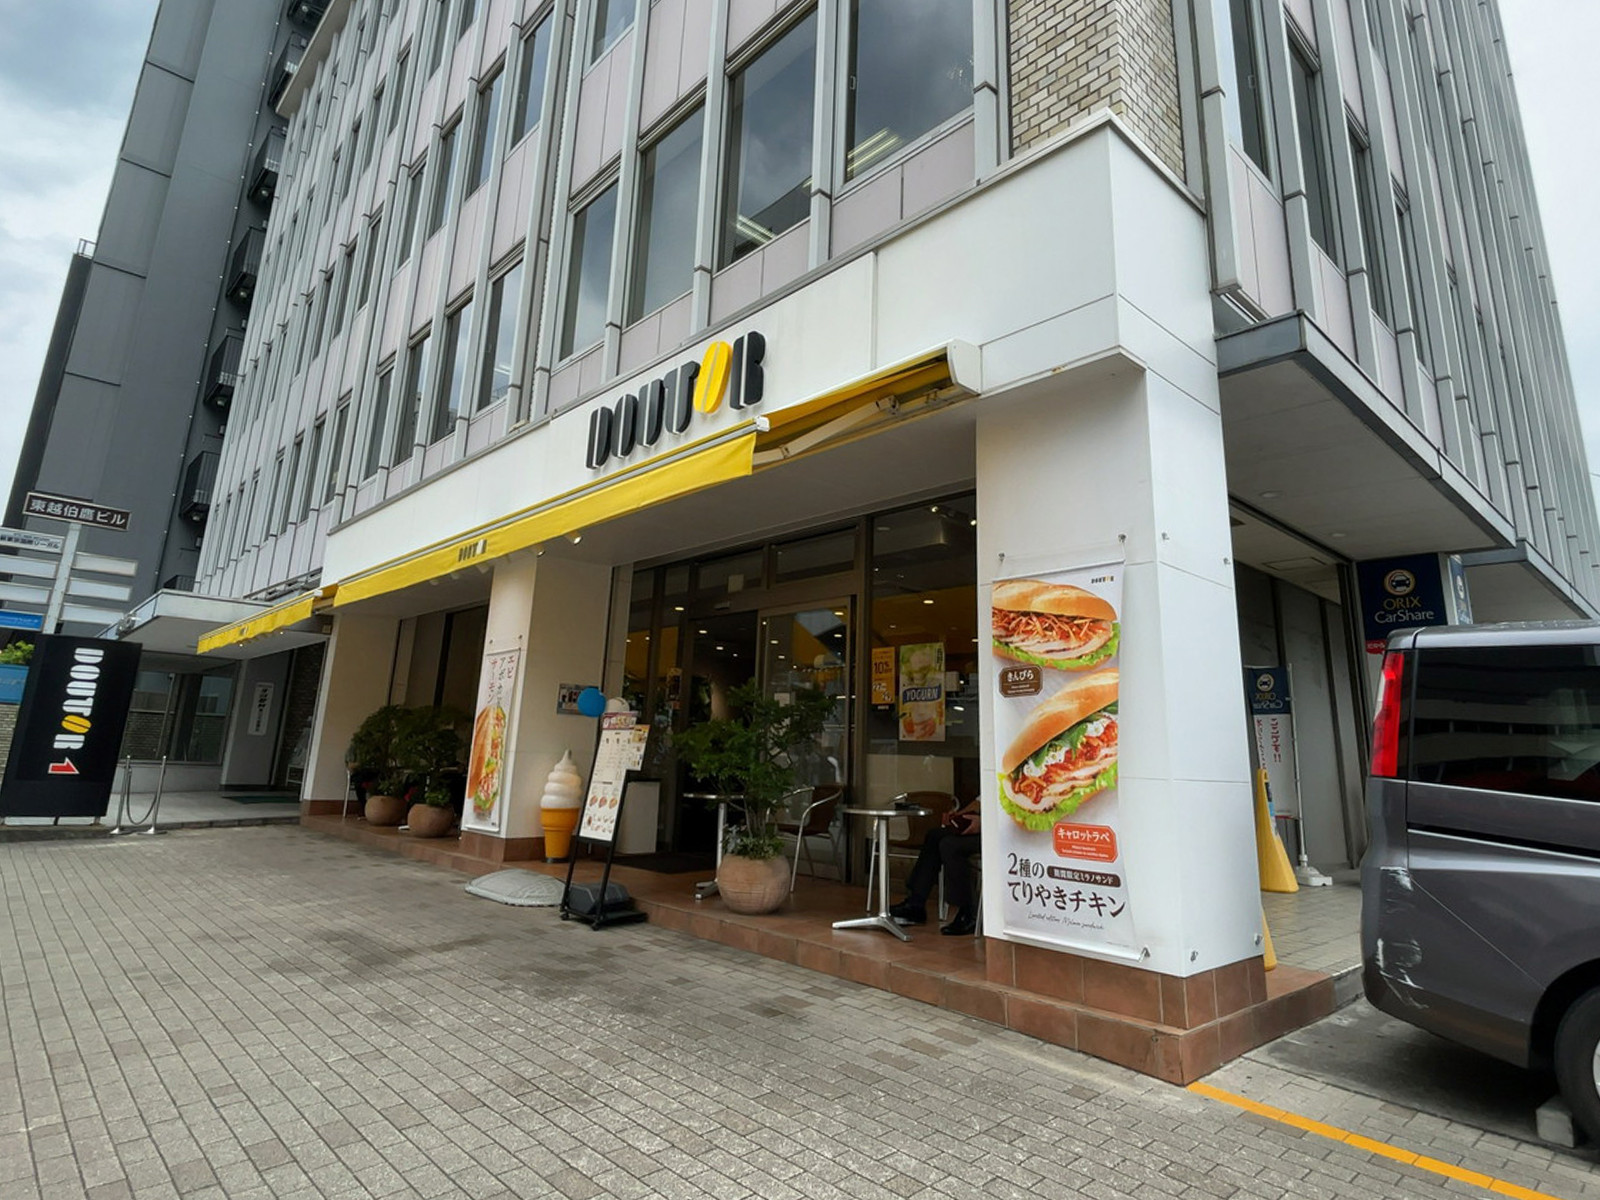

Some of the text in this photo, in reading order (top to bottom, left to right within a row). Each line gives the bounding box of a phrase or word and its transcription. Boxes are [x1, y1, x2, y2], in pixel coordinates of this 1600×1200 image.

[586, 331, 766, 470] DOUTOR
[1374, 609, 1435, 624] CarShare
[1383, 596, 1422, 610] ORIX
[53, 647, 104, 750] DOUTOR
[1007, 852, 1045, 879] 2種の
[1007, 880, 1126, 918] てりやきチキン
